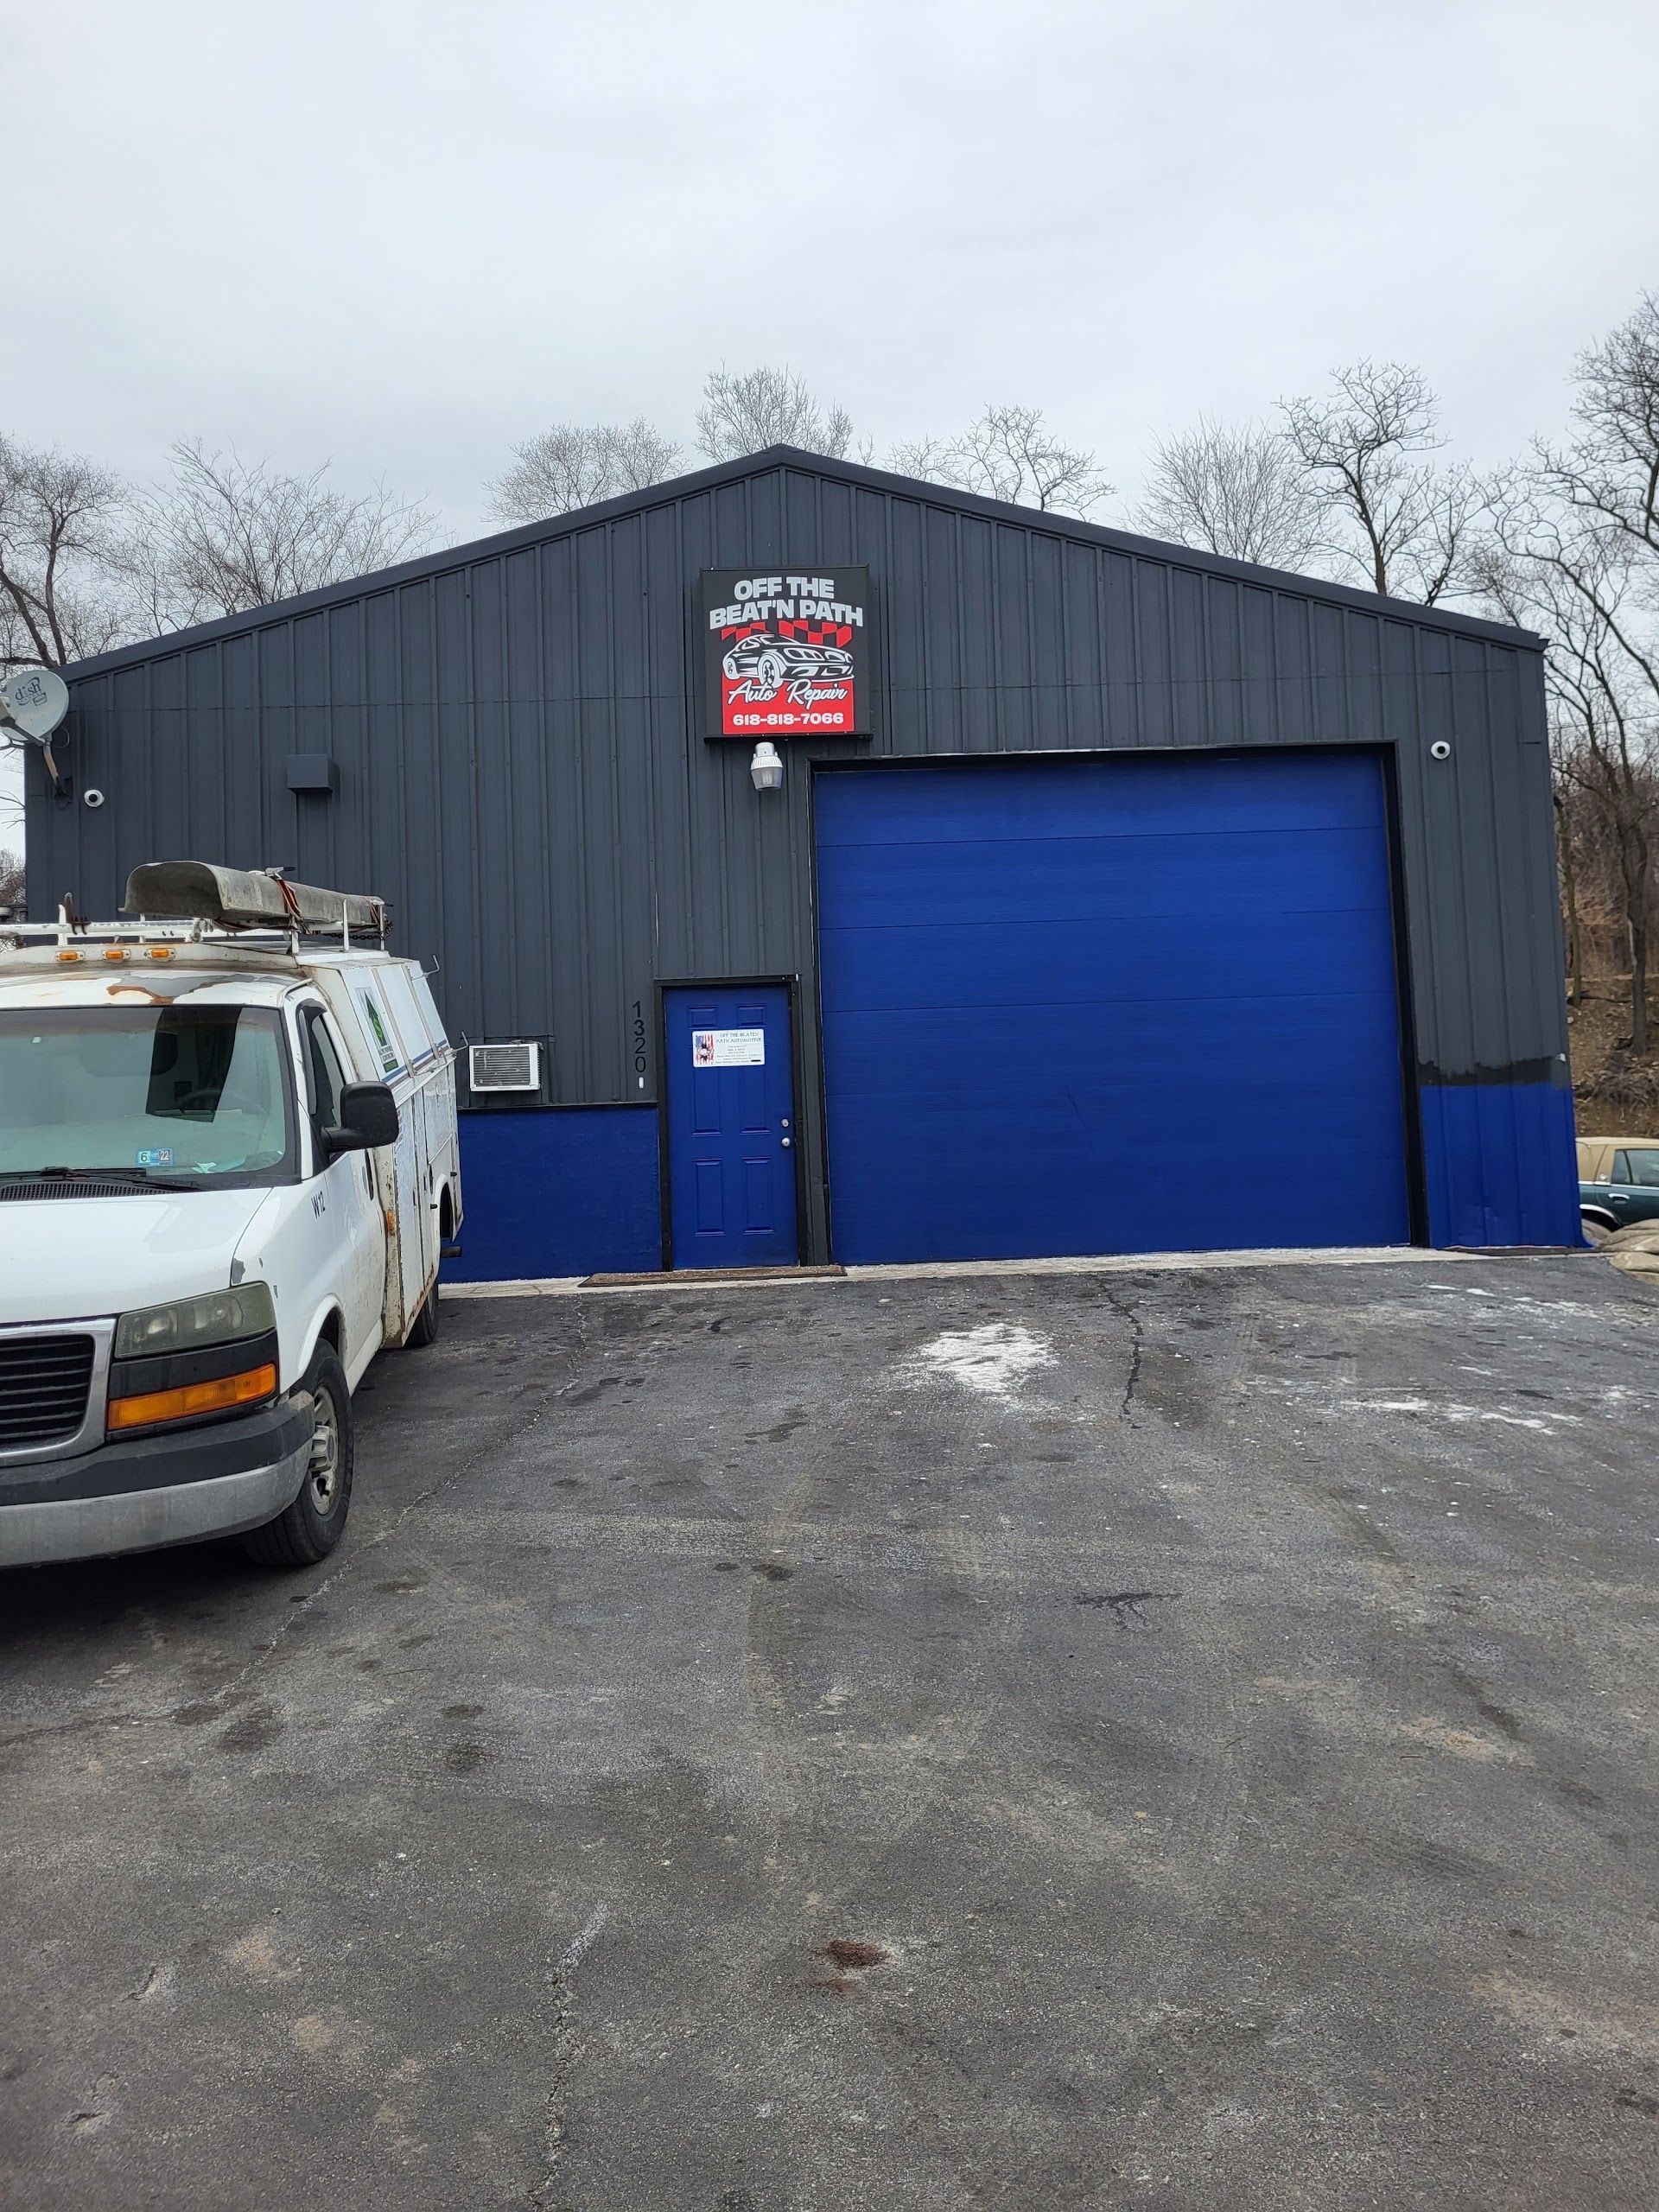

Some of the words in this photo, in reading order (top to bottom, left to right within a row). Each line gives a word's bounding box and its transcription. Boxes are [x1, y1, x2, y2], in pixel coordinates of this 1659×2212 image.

[734, 577, 782, 601] OFF
[786, 577, 834, 600] THE
[709, 600, 794, 630] BEAT'N
[799, 600, 863, 626] PATH
[16, 682, 41, 701] dish
[728, 679, 777, 704] Auto
[786, 679, 848, 710] Repair
[733, 713, 843, 726] 618-818-7066
[632, 1001, 646, 1073] 1320
[141, 1152, 148, 1162] 6
[160, 1150, 169, 1160] 22
[310, 1191, 326, 1220] W12
